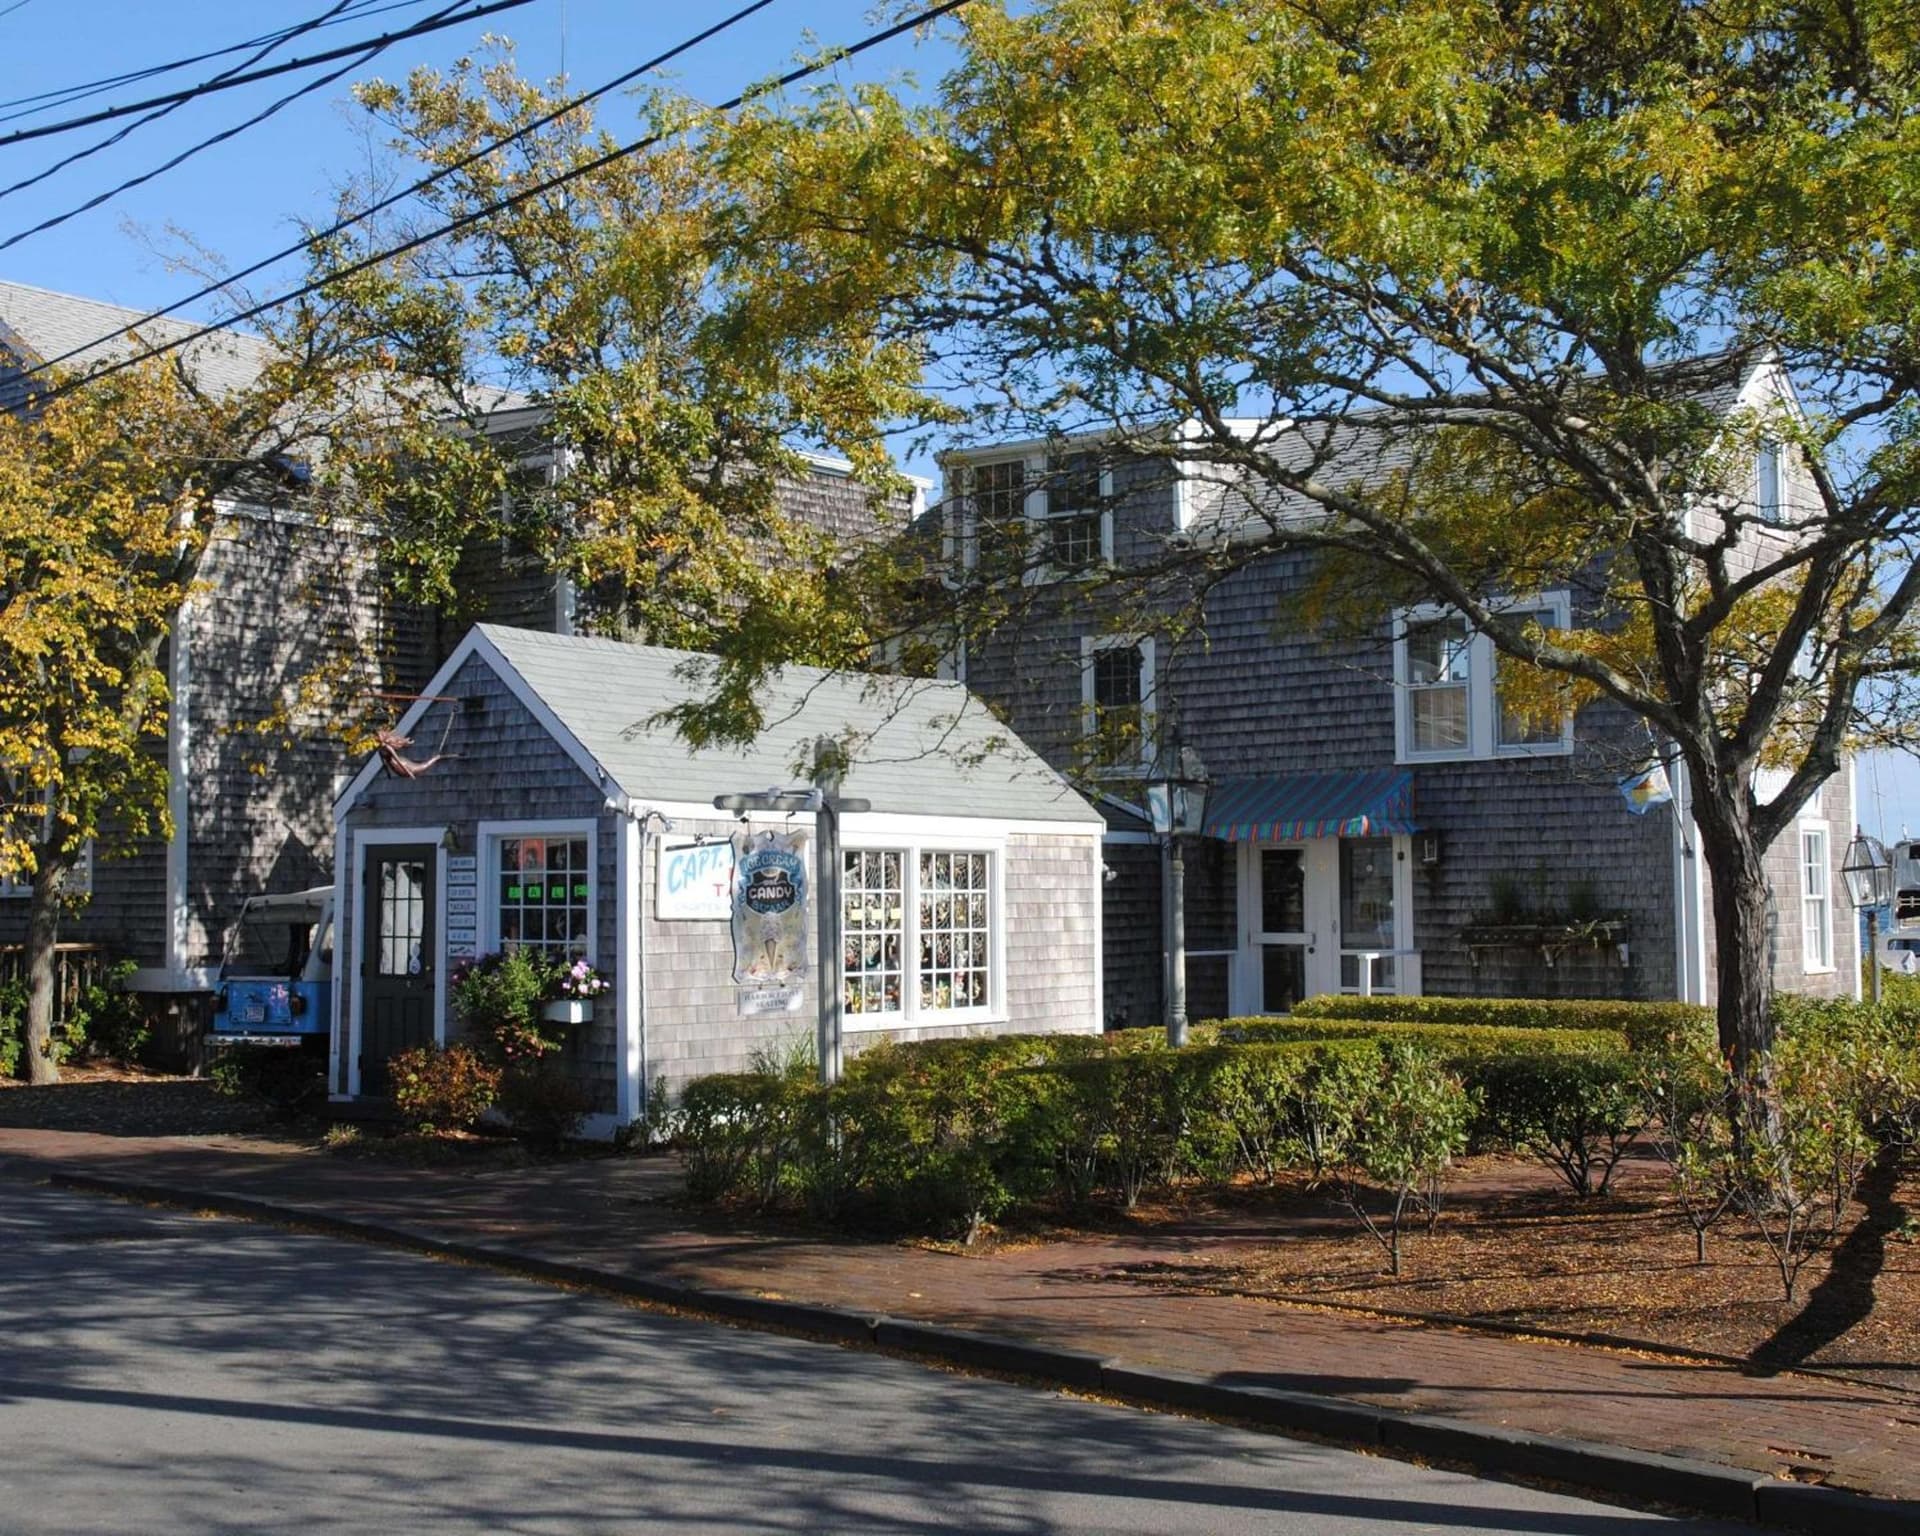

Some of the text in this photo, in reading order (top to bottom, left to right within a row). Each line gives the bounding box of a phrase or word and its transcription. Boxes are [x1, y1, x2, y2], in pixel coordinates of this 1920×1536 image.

[762, 854, 798, 868] CREAM
[667, 847, 724, 894] CAPT.
[748, 886, 793, 900] CANDY
